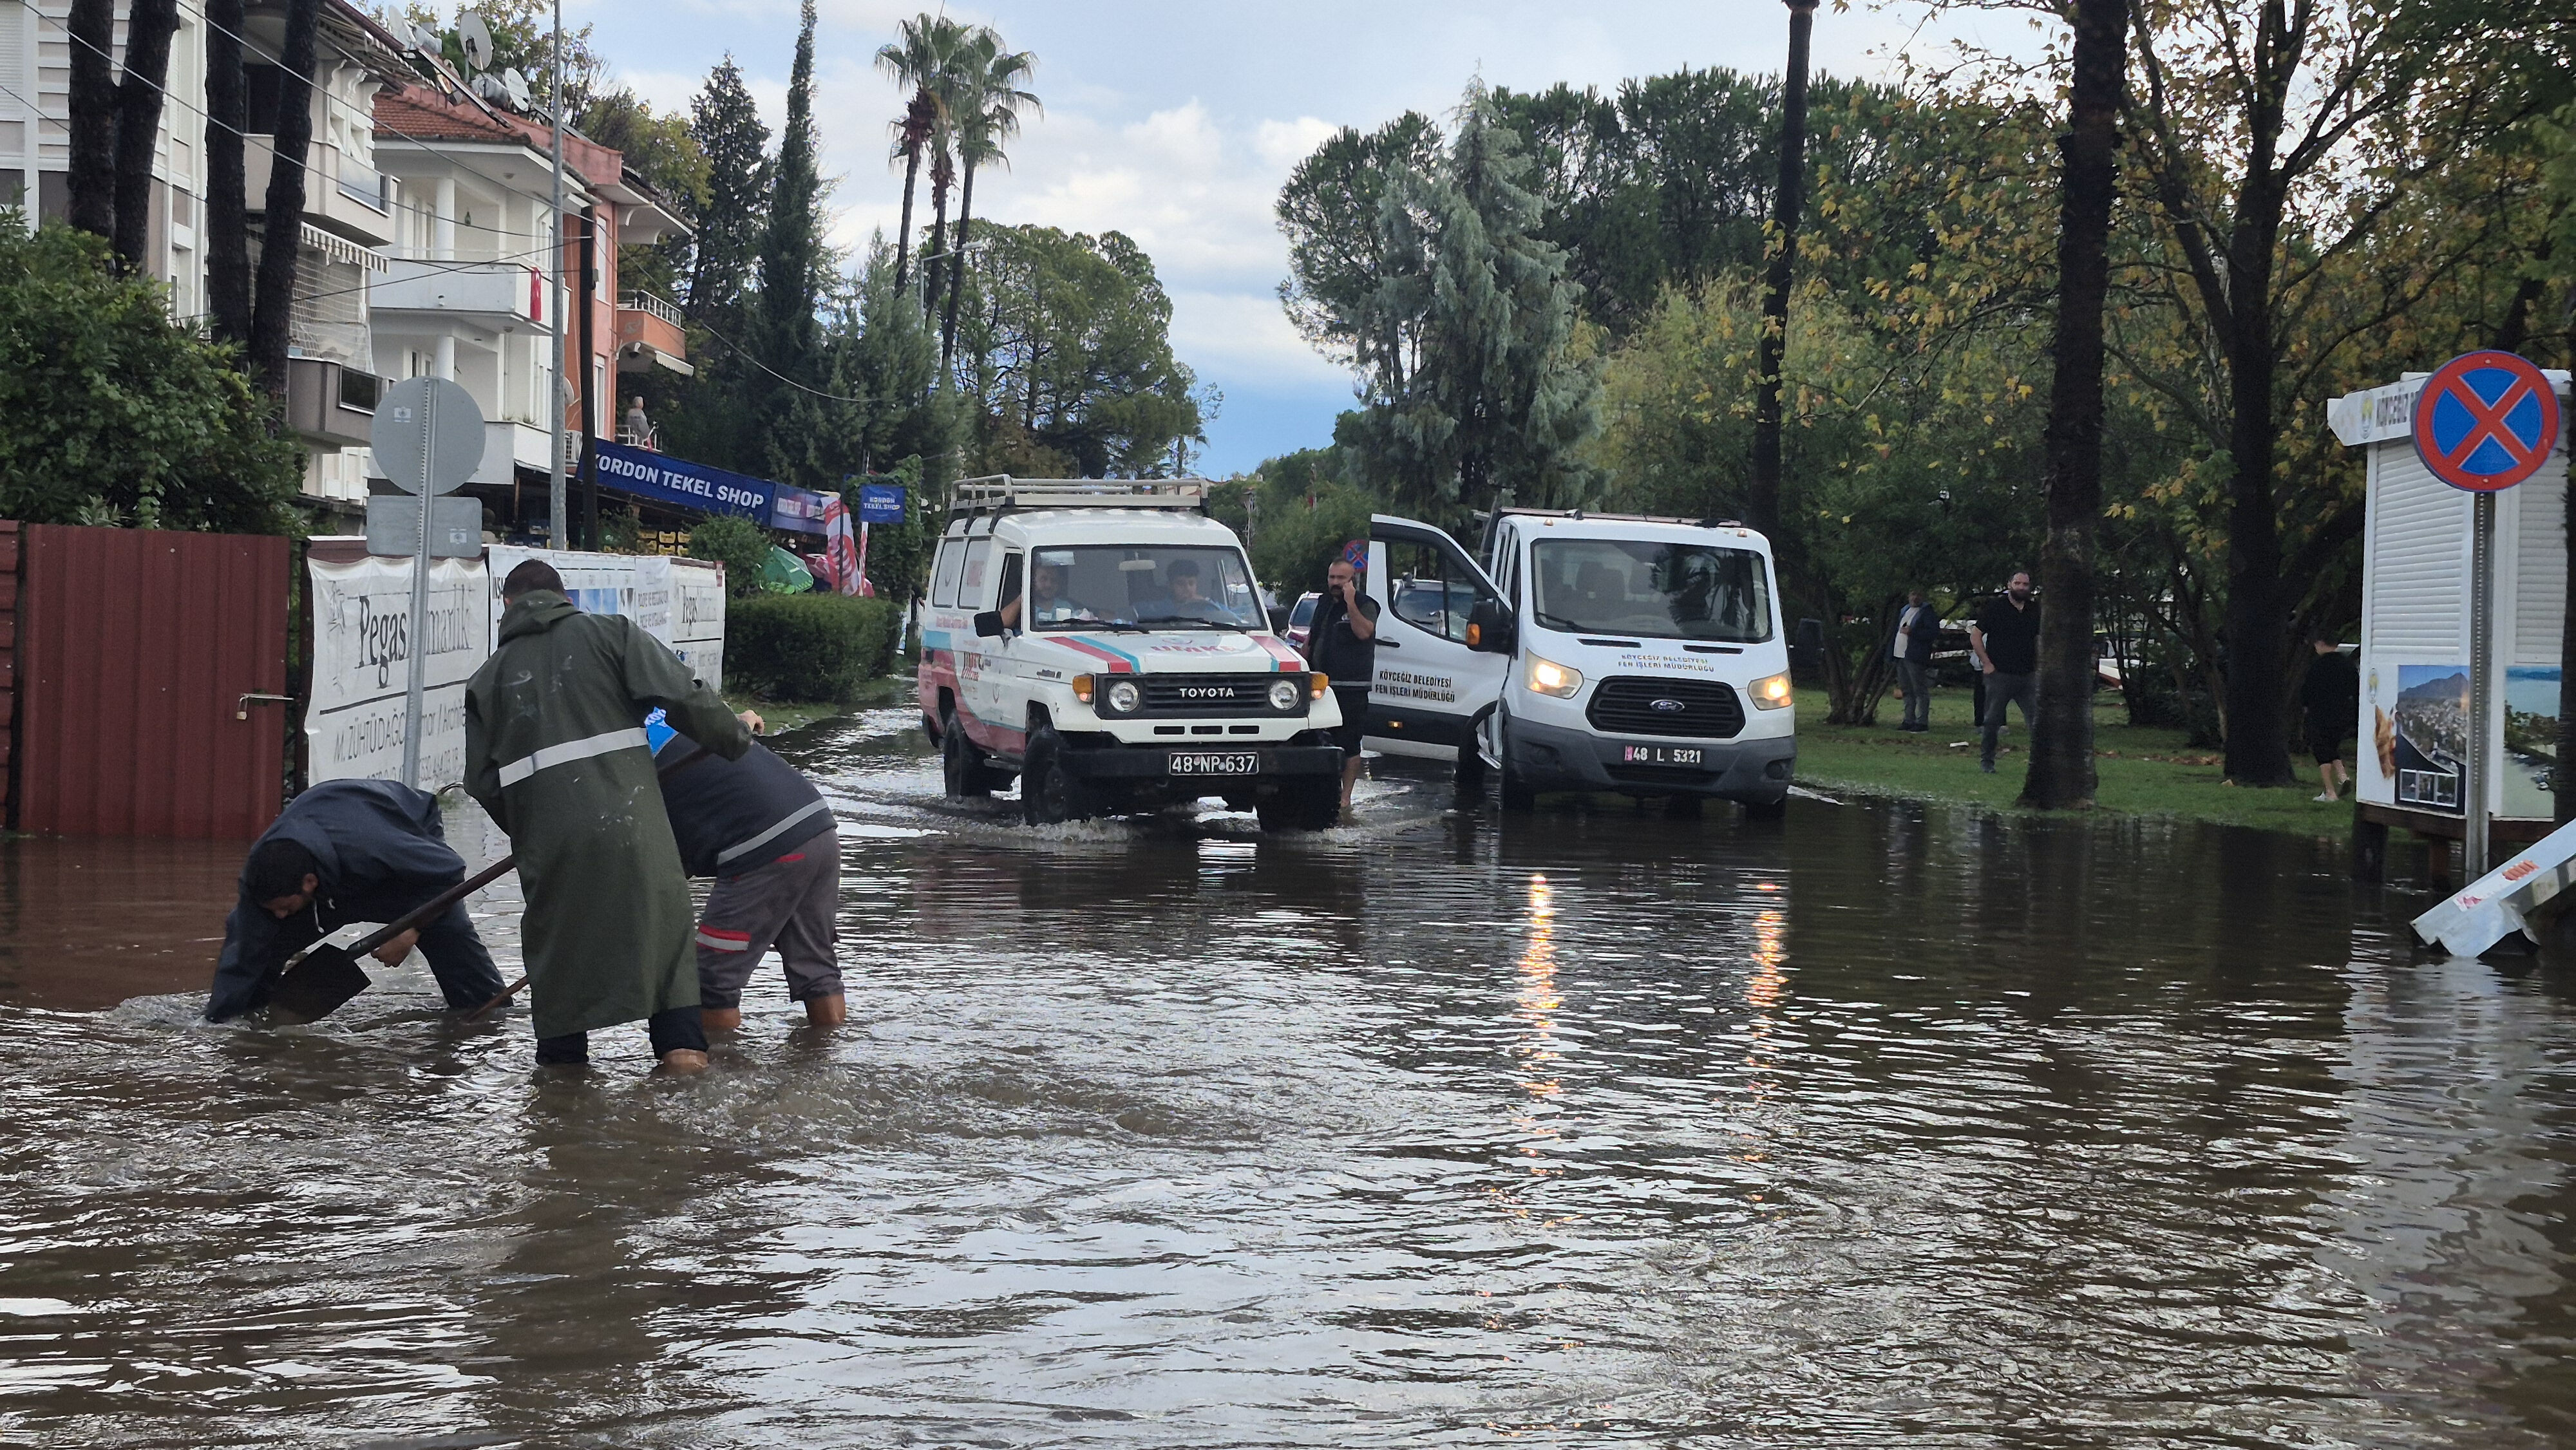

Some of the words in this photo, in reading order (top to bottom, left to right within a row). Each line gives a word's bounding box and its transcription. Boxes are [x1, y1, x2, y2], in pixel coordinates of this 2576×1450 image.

[663, 471, 714, 498] TEKEL
[717, 485, 764, 509] SHOP
[354, 595, 407, 688] Pegas
[1379, 669, 1412, 684] KÖYCEĞİZ
[1414, 674, 1452, 688] BELEDİYESİ
[1179, 688, 1235, 698] TOYOTA
[1376, 684, 1388, 695] FEN
[1390, 683, 1411, 698] İŞLERİ
[1412, 687, 1455, 703] MÜDÜRLÜĞÜ
[1172, 756, 1193, 773] 48
[1200, 756, 1221, 773] NP
[1226, 755, 1256, 773] 637
[1633, 747, 1648, 761] 48
[1656, 748, 1665, 762] L
[1673, 749, 1701, 764] 5321
